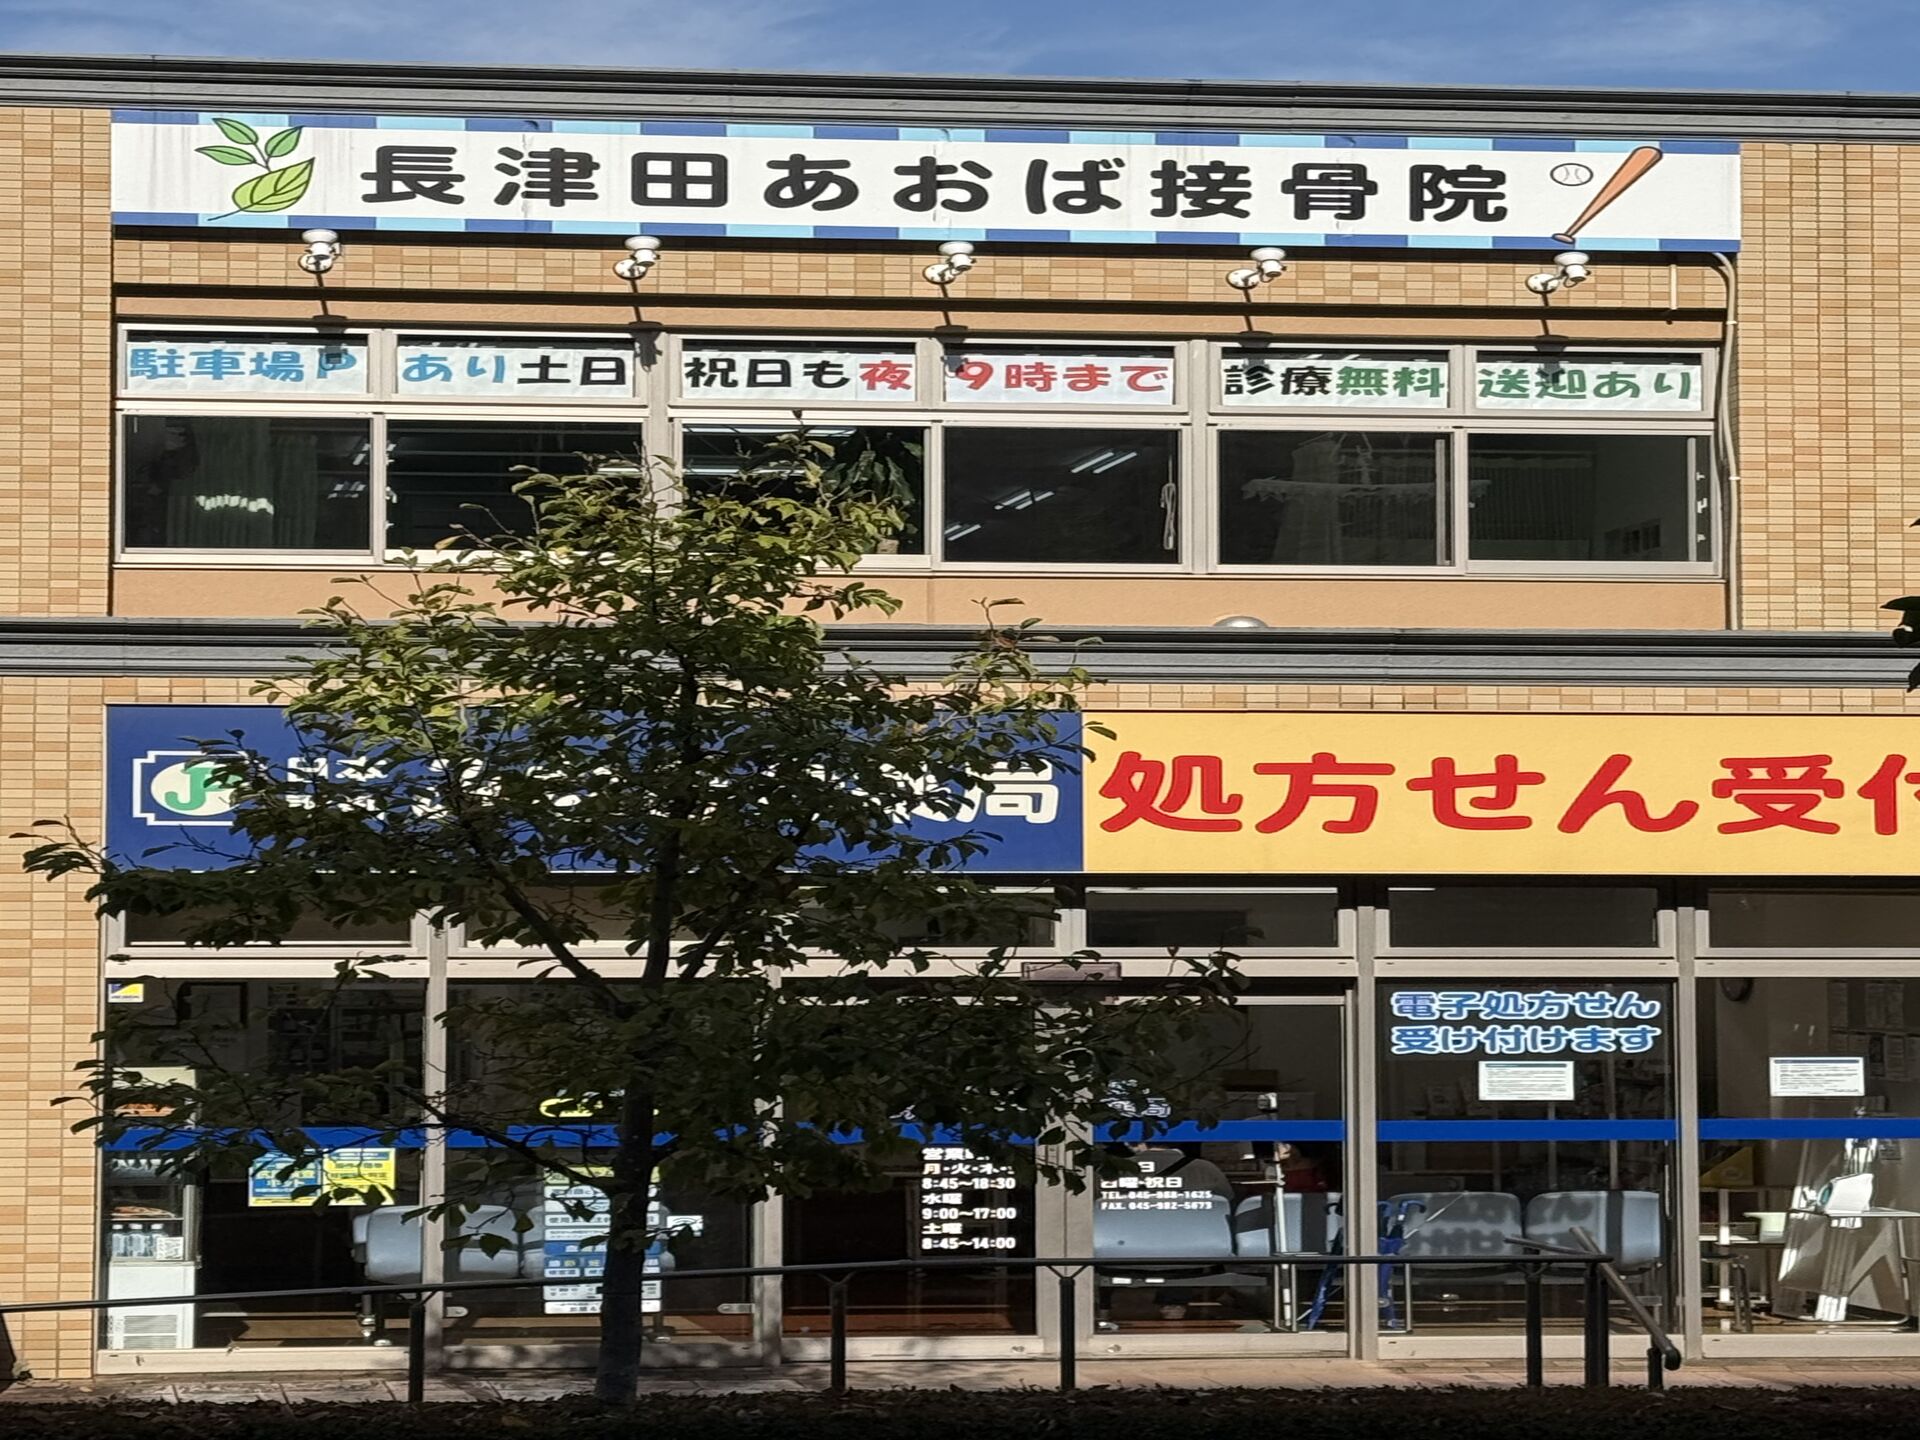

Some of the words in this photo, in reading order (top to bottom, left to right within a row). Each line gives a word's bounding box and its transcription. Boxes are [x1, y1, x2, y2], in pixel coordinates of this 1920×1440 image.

[361, 145, 1508, 222] 長津田あおば接骨院
[1391, 991, 1661, 1020] 電子処方せん
[1391, 1025, 1662, 1054] 受け付けます
